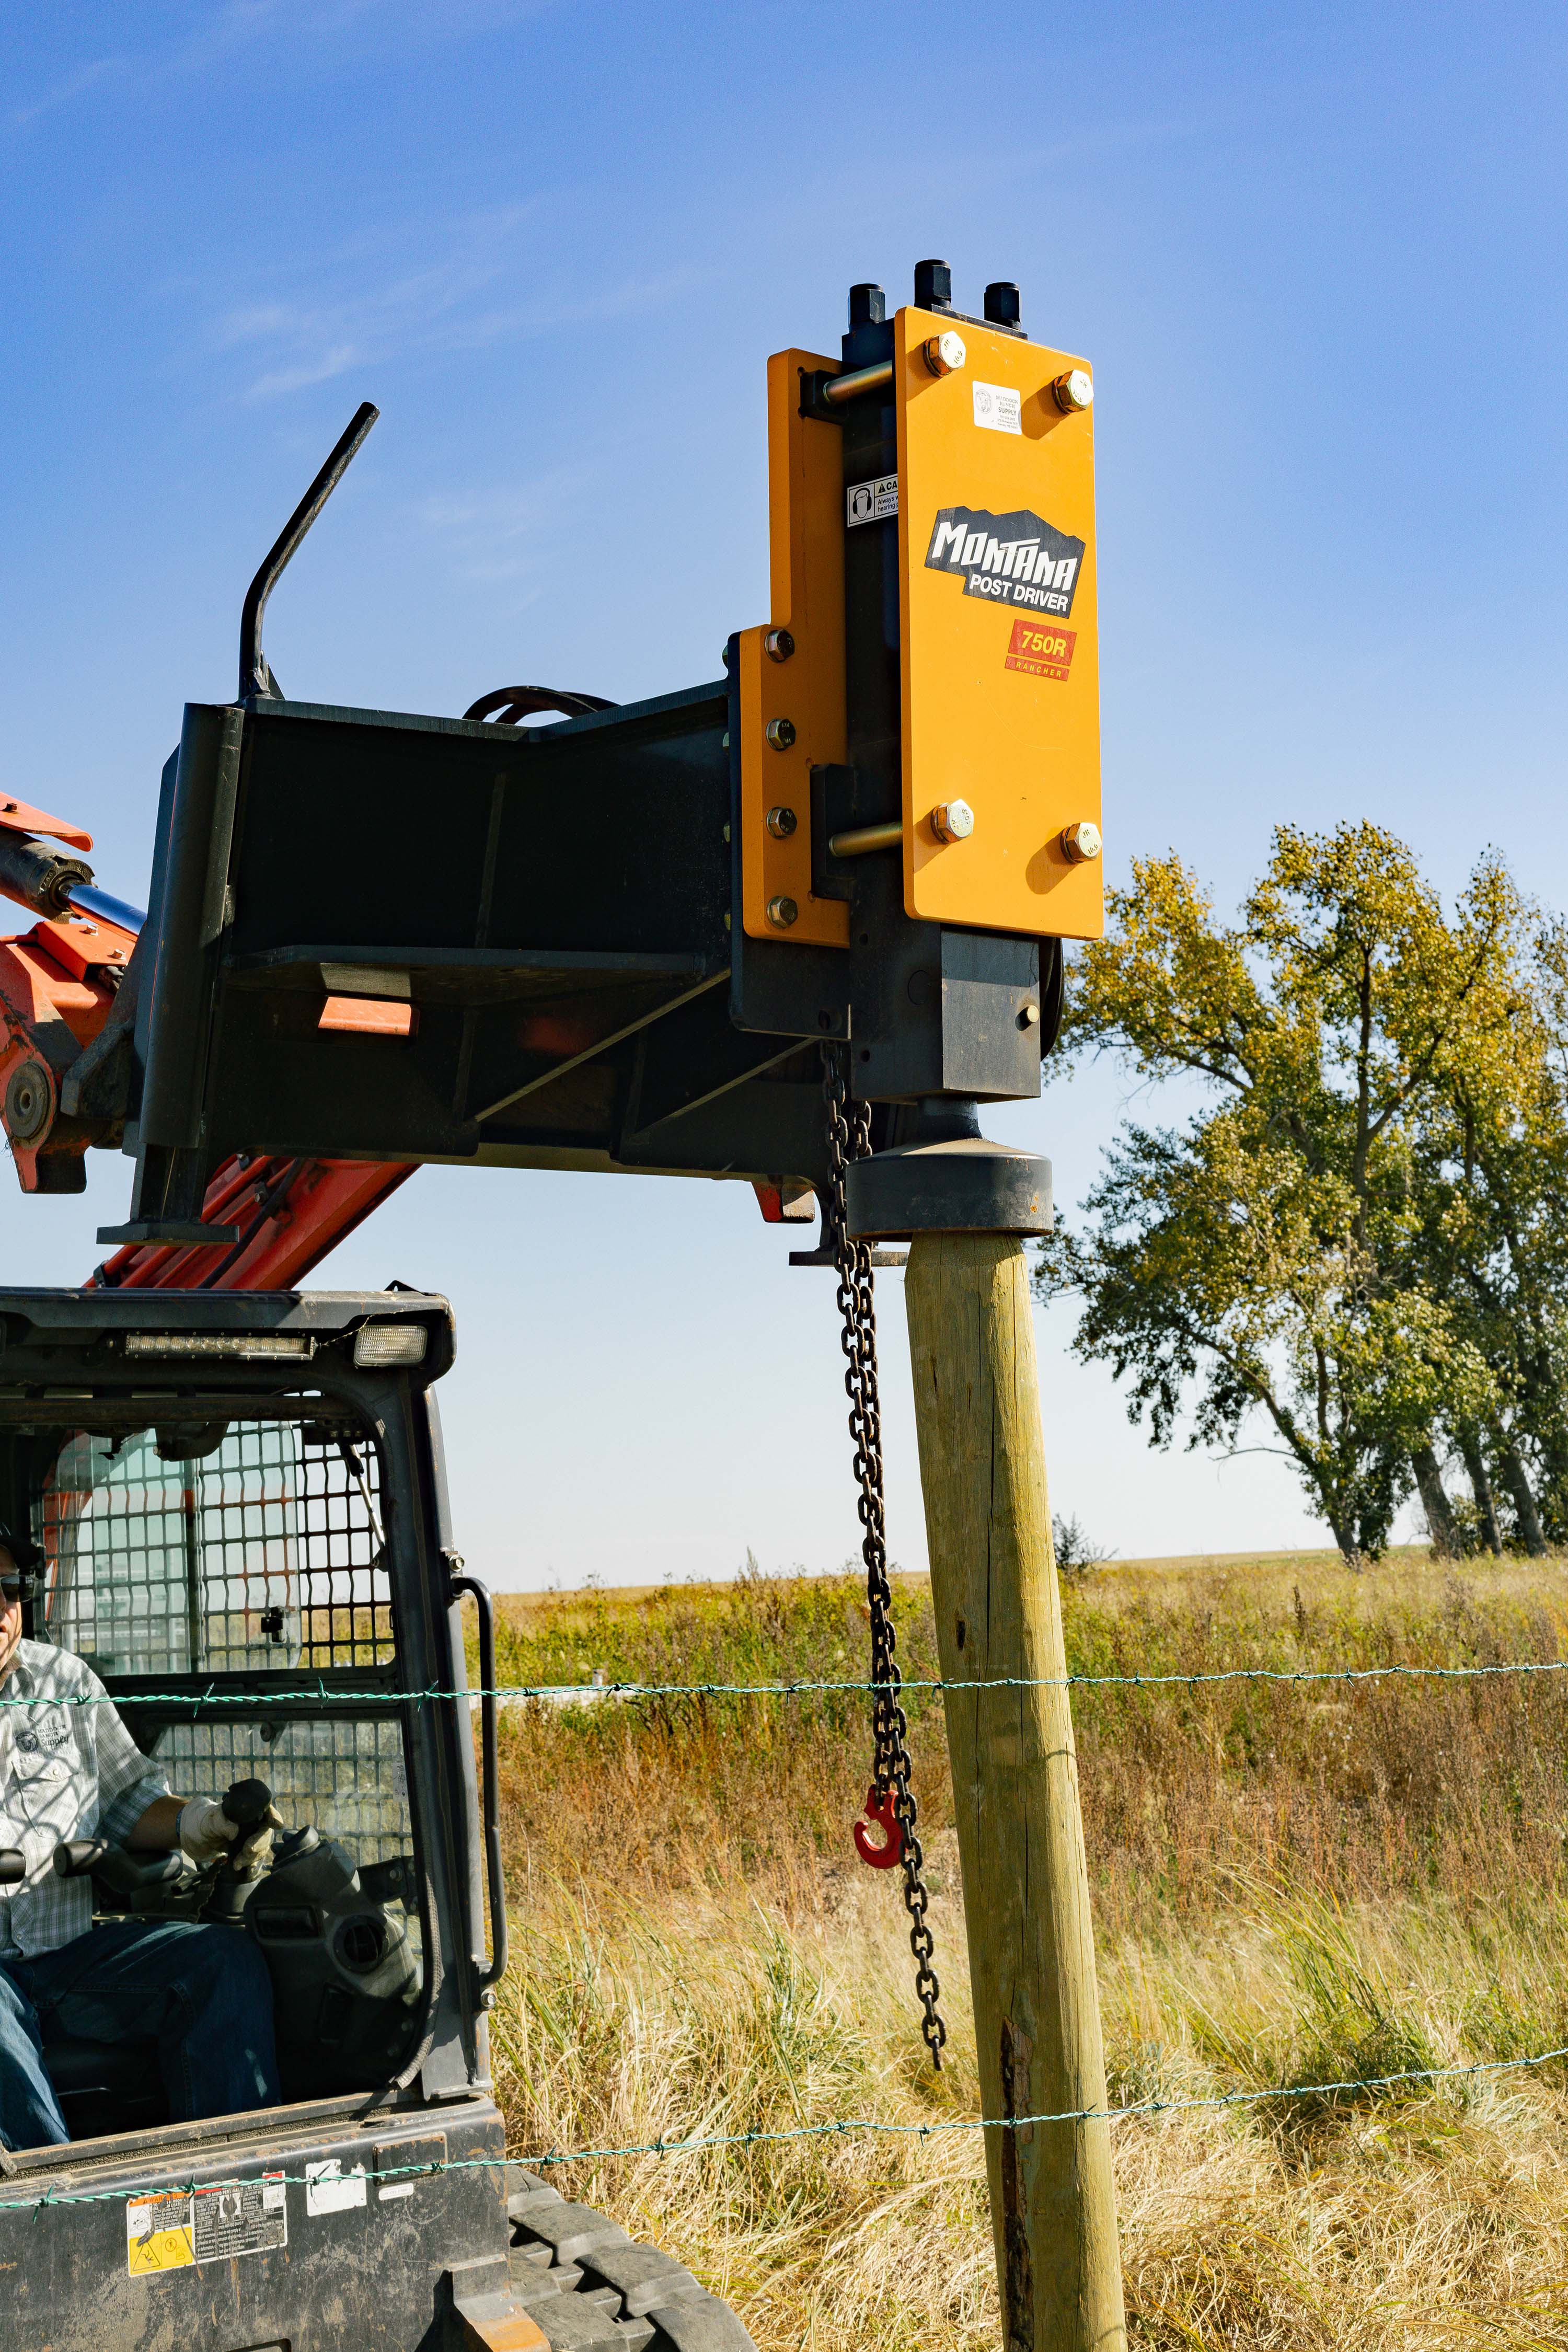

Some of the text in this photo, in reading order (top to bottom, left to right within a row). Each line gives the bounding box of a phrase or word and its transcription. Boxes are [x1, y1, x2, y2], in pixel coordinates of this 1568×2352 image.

[998, 407, 1017, 416] SUPPLY
[886, 480, 898, 490] CA
[878, 497, 894, 505] Always
[878, 503, 895, 512] hearing
[932, 521, 1078, 591] MONTANA
[969, 574, 1068, 612] POST DRIVER
[1021, 630, 1067, 657] 750R
[1016, 661, 1062, 678] RANCHER
